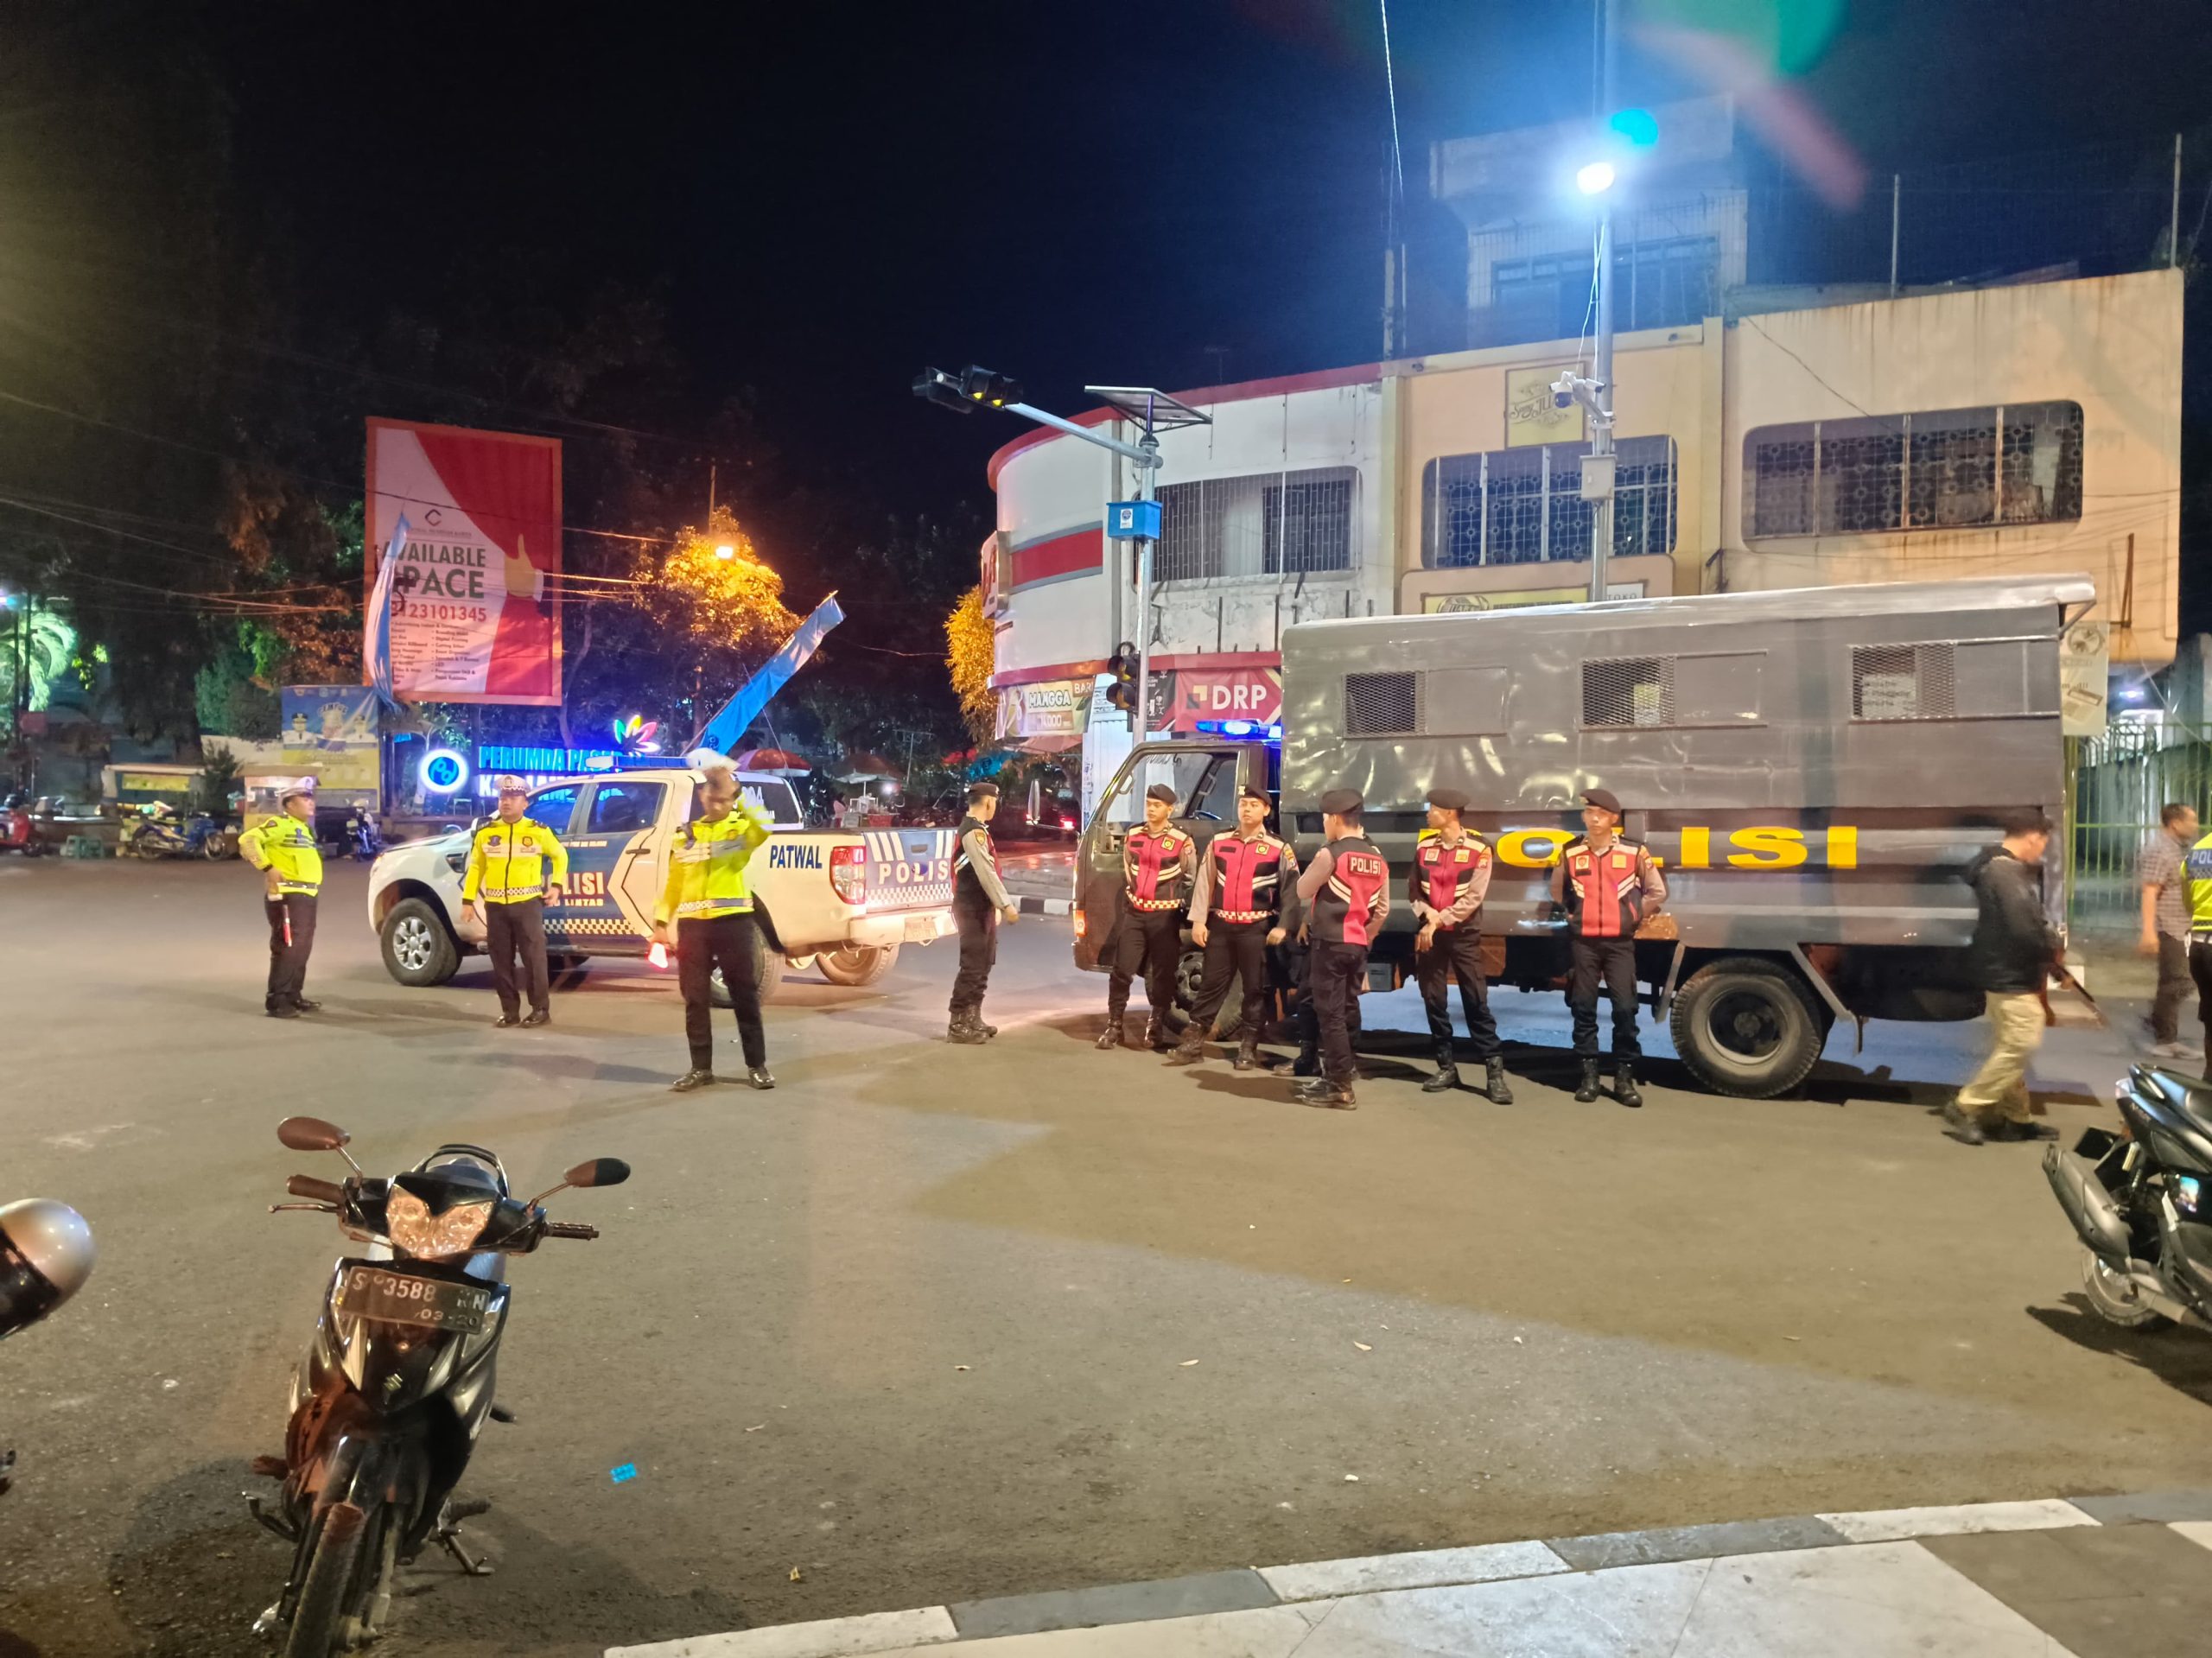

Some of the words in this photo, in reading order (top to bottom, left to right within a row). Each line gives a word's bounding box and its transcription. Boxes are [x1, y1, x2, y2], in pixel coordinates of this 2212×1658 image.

[393, 566, 484, 598] PACE
[1029, 690, 1071, 708] MANGGA
[1212, 684, 1268, 710] DRP
[479, 746, 565, 769] PERUMDA
[769, 845, 823, 869] PATWAL
[1350, 856, 1381, 876] POLISI
[352, 1272, 367, 1291] S
[383, 1277, 436, 1302] 3588
